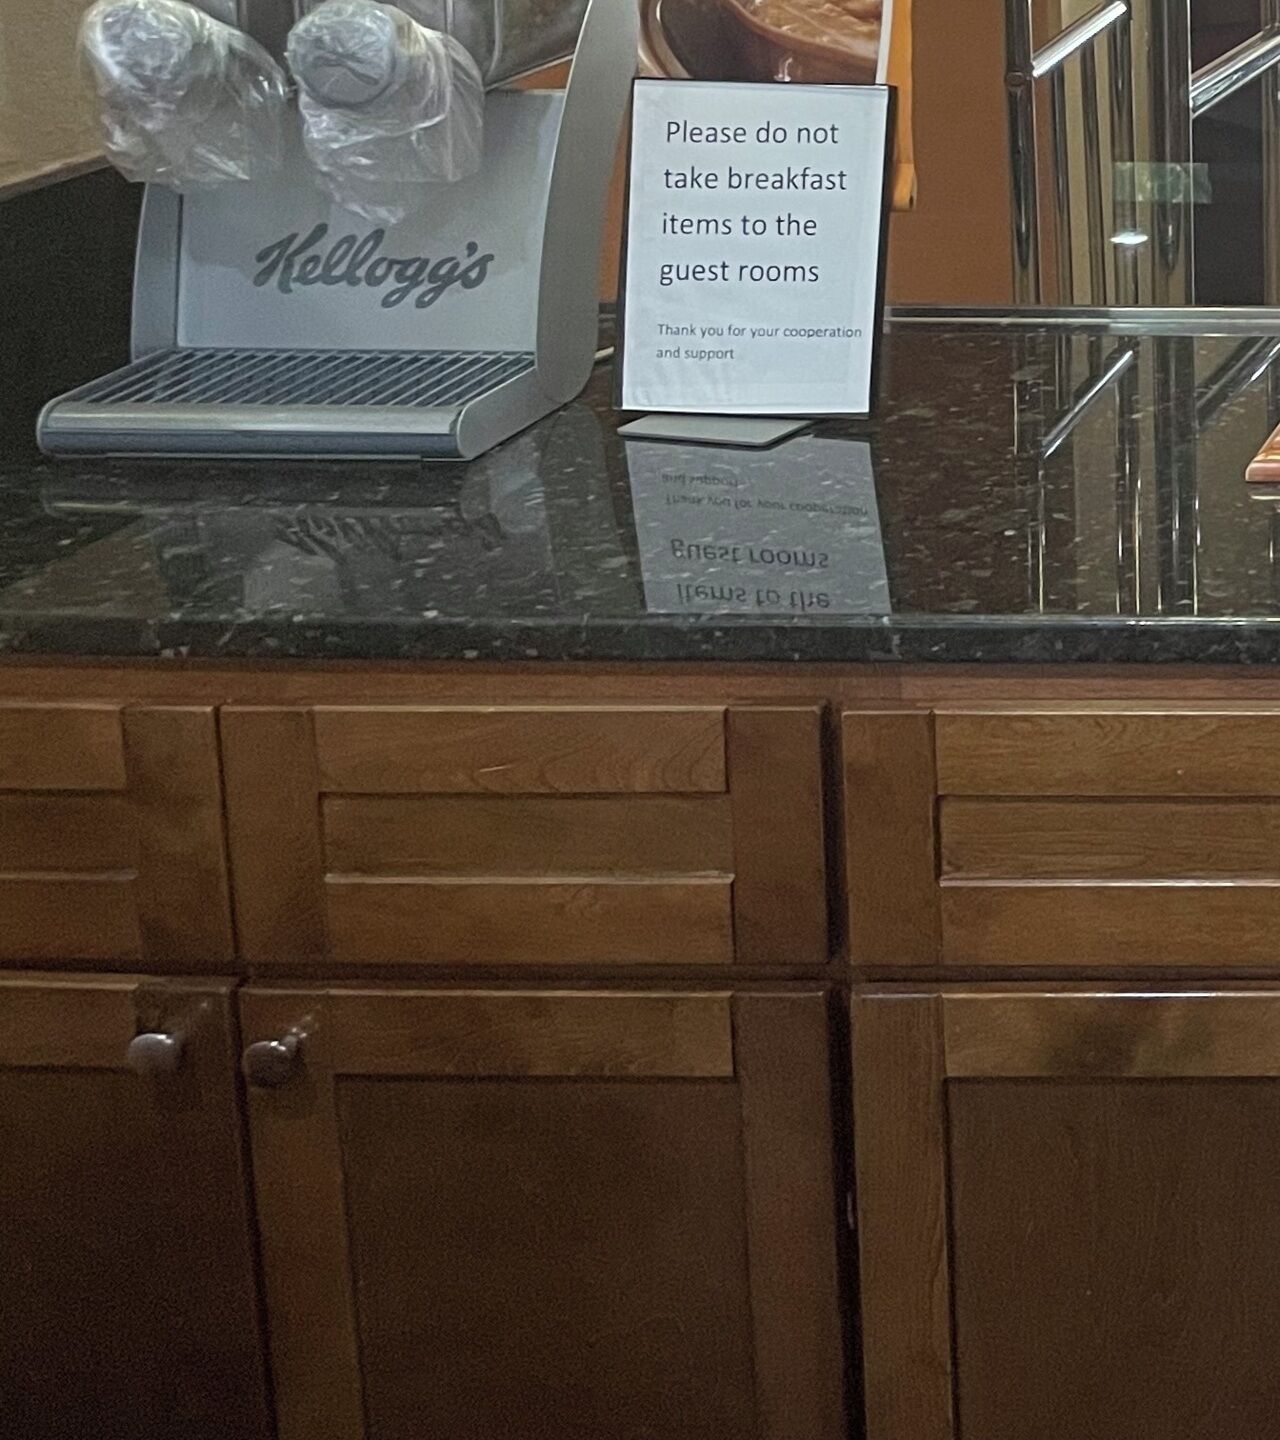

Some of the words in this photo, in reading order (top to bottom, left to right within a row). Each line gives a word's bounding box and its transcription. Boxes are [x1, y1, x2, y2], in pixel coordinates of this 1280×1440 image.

[666, 120, 747, 143] Please
[756, 120, 787, 143] do
[797, 123, 839, 144] not
[664, 166, 718, 189] take
[728, 166, 847, 190] breakfast
[663, 212, 732, 235] items
[741, 215, 767, 235] to
[776, 213, 817, 235] the
[253, 222, 495, 309] Kellogg's
[660, 261, 729, 286] guest
[739, 264, 819, 282] rooms
[658, 324, 696, 336] Thank
[700, 326, 723, 338] you
[728, 324, 745, 336] for
[750, 327, 780, 339] your
[783, 326, 862, 339] cooperation
[656, 347, 680, 358] and
[684, 348, 734, 361] support
